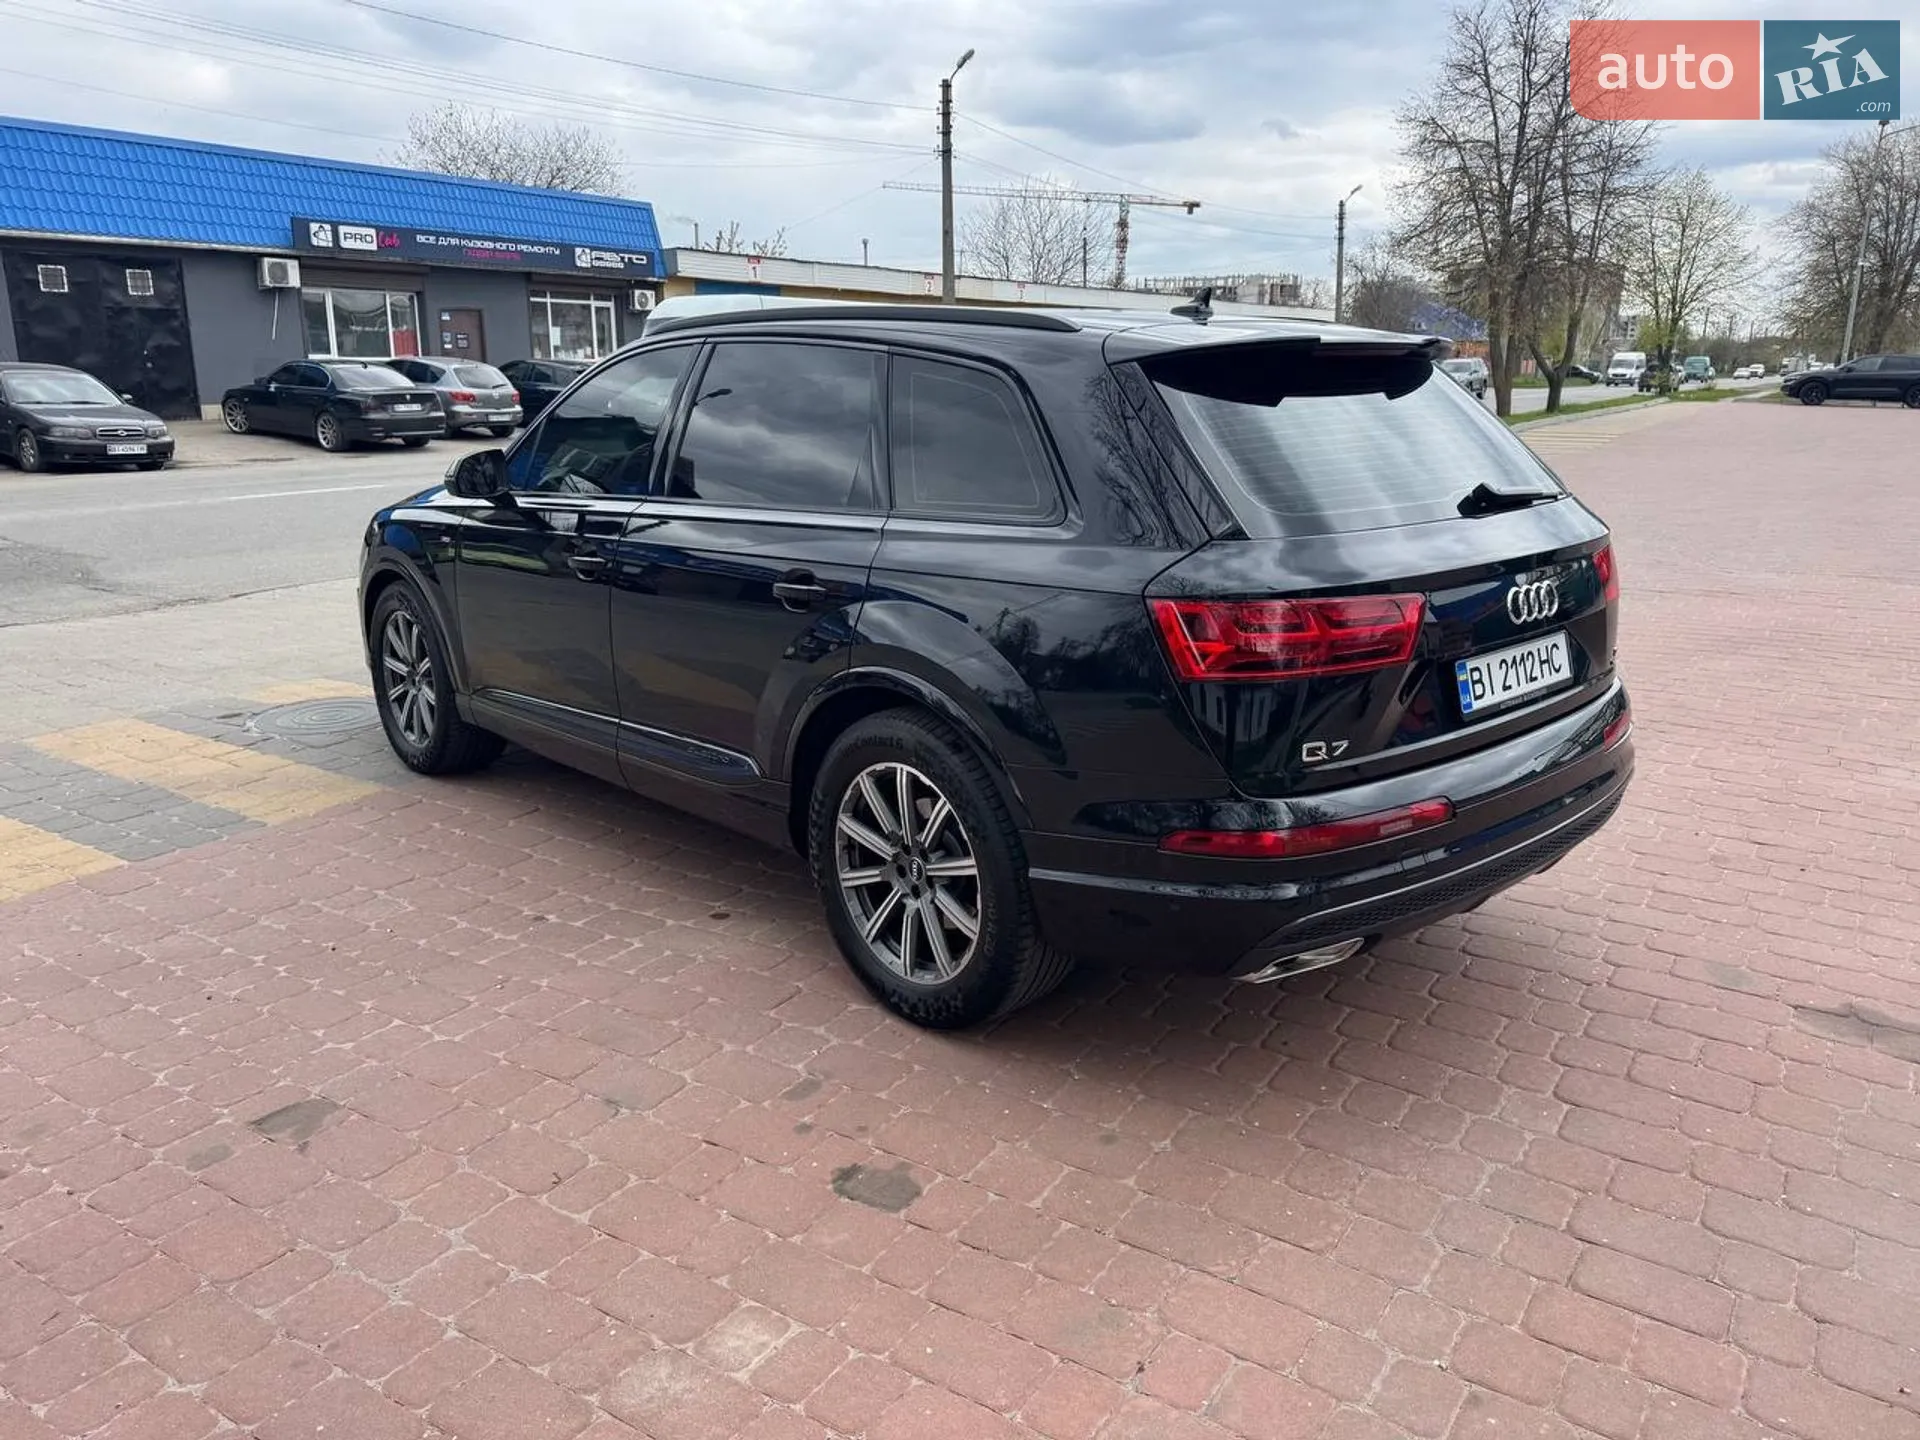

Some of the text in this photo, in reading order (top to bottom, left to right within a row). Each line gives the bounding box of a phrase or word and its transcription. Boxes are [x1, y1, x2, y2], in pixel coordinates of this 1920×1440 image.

[343, 230, 400, 248] PRO Lab
[416, 234, 436, 245] ВСЕ
[438, 237, 459, 247] ДЛЯ
[460, 239, 516, 251] КУЗОВНОГО
[517, 243, 560, 255] РЕМОНТУ
[1302, 739, 1350, 762] Q7
